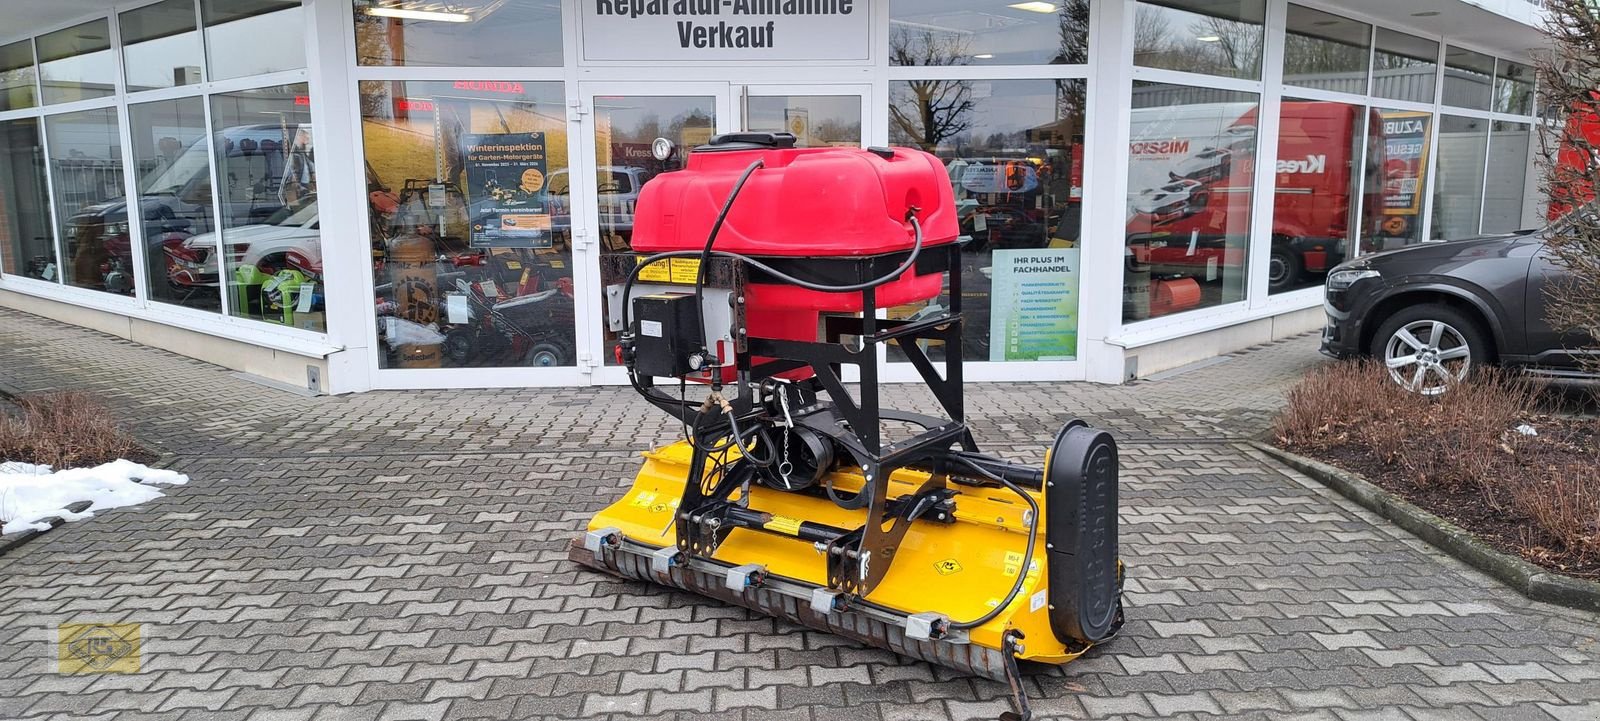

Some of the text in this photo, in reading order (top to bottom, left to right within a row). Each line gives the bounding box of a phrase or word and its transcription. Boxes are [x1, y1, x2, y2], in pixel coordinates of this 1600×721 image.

[677, 21, 775, 48] Verkauf
[467, 143, 543, 153] Winterinspektion
[625, 146, 652, 157] Kress
[478, 153, 544, 161] Garten-Motorgeräte
[1013, 256, 1029, 264] IHR
[1030, 256, 1052, 264] PLUS
[1013, 265, 1071, 273] FACHHANDEL
